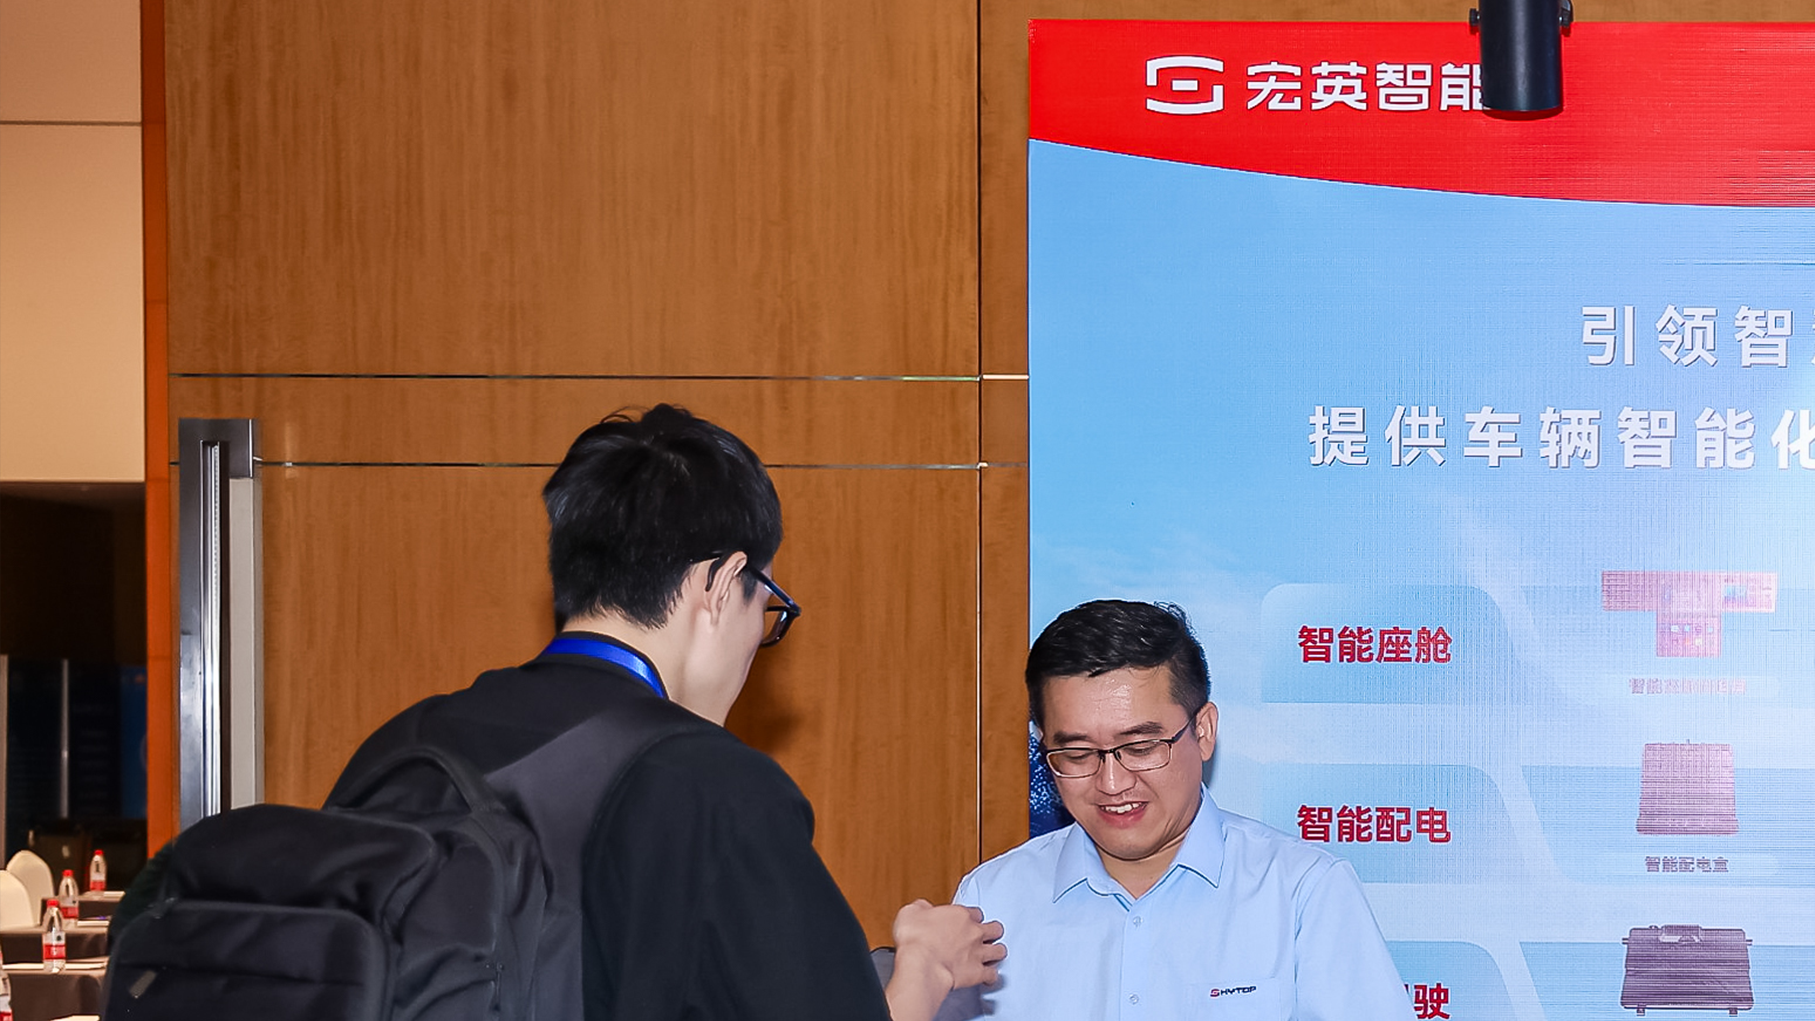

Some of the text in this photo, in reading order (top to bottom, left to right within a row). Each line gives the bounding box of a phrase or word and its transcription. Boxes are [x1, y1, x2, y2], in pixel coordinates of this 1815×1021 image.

[1247, 61, 1490, 111] 宏英智能
[1299, 626, 1453, 664] 智能座舱
[1298, 805, 1452, 844] 智能配电
[1645, 856, 1728, 873] 智能配电盒
[1404, 983, 1450, 1020] 驶
